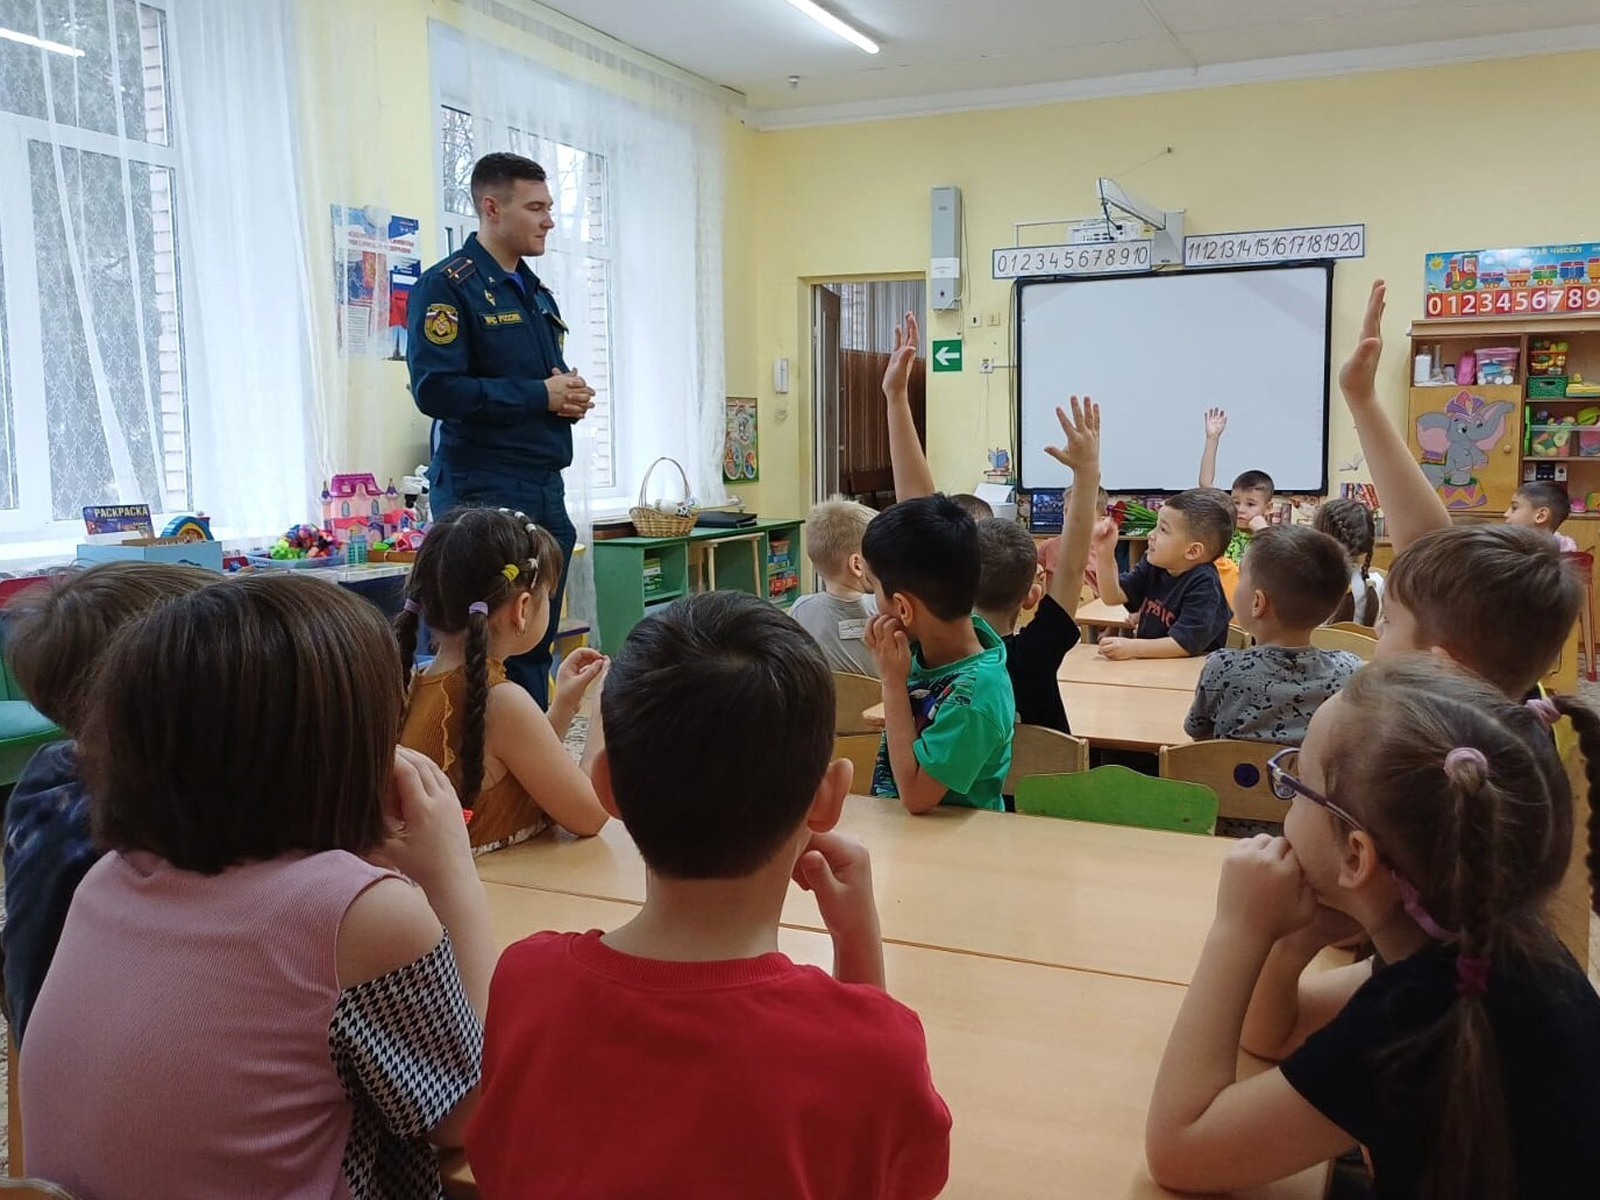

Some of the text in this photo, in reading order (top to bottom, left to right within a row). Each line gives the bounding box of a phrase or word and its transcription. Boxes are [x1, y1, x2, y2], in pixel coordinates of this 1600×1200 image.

[997, 246, 1148, 272] 0 1 2 3 4 5 6 7 8 9 10
[1189, 232, 1360, 260] 11 12 13 14 15 16 17 18 19 20
[1428, 288, 1600, 314] 0 1 2 3 4 5 6 7 8 9
[94, 506, 149, 518] РАСКРАСКА
